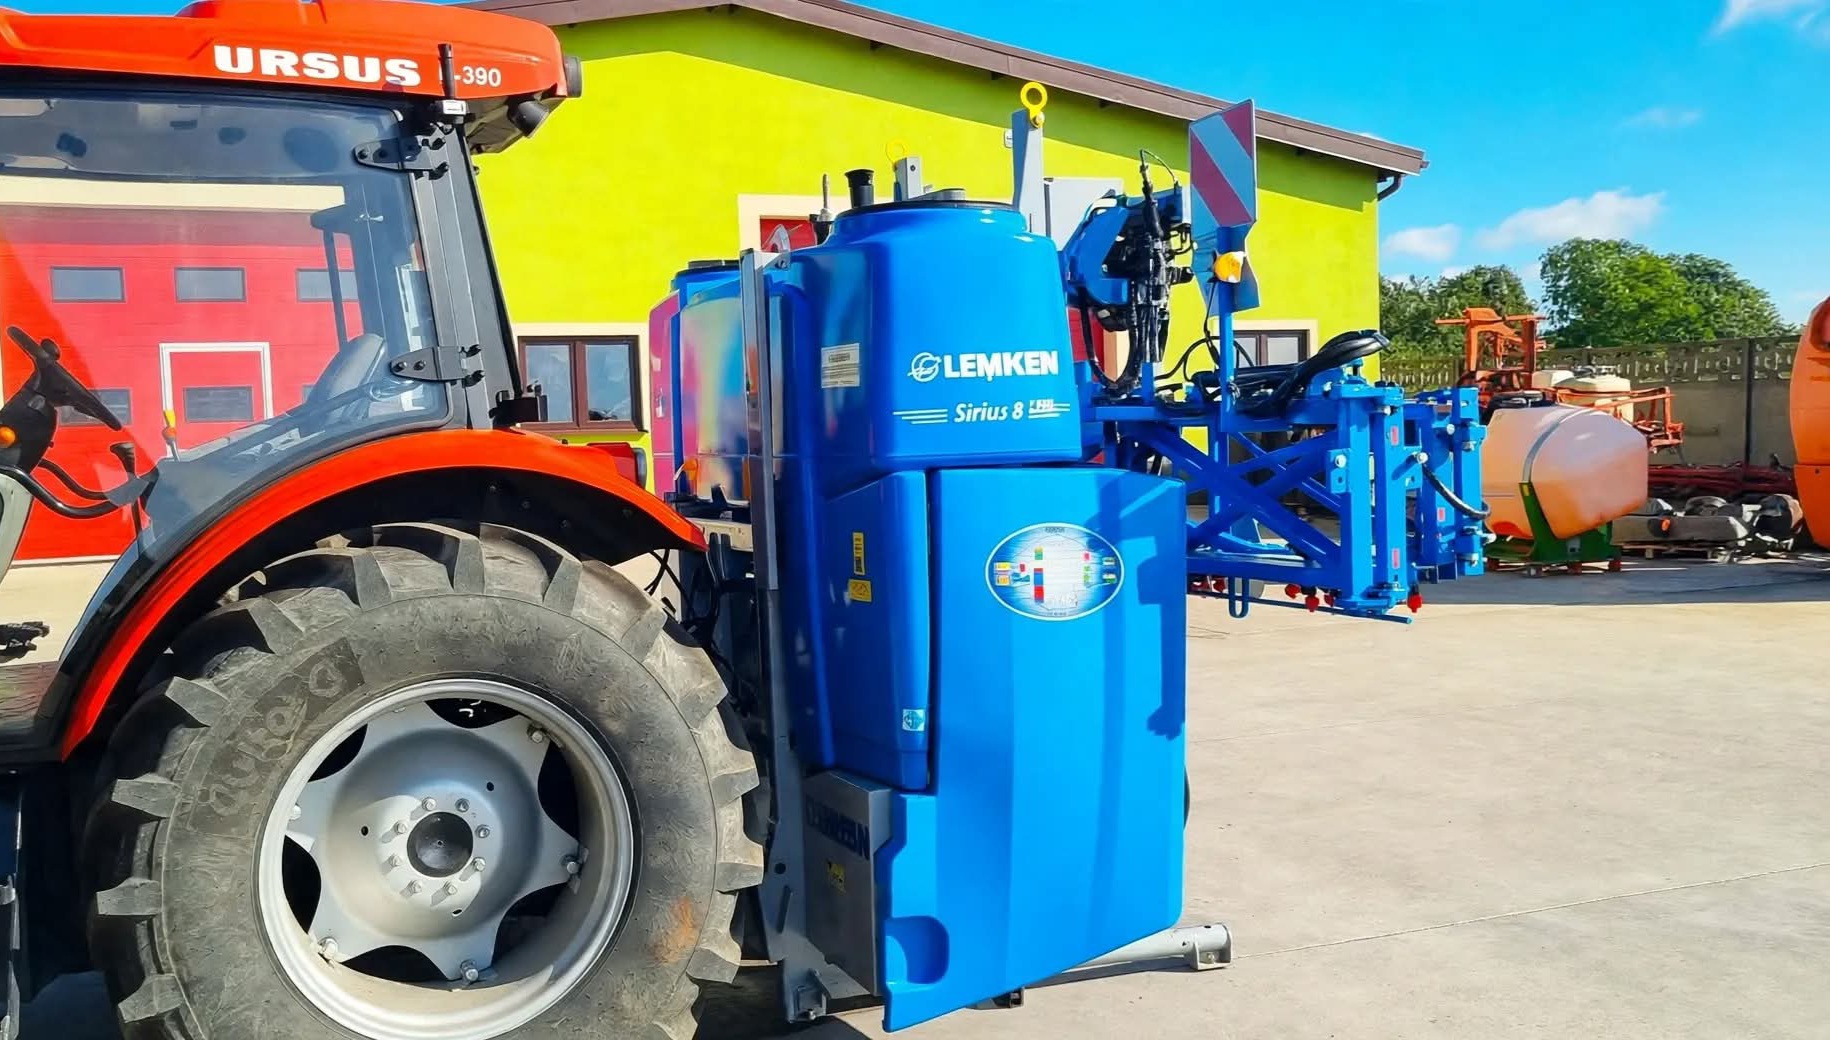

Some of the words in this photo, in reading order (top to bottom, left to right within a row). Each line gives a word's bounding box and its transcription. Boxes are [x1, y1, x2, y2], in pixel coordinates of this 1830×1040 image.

[213, 45, 421, 87] URSUS
[439, 65, 502, 88] -390
[943, 350, 1059, 379] LEMKEN
[954, 401, 1009, 423] Sirius
[1011, 401, 1025, 420] 8
